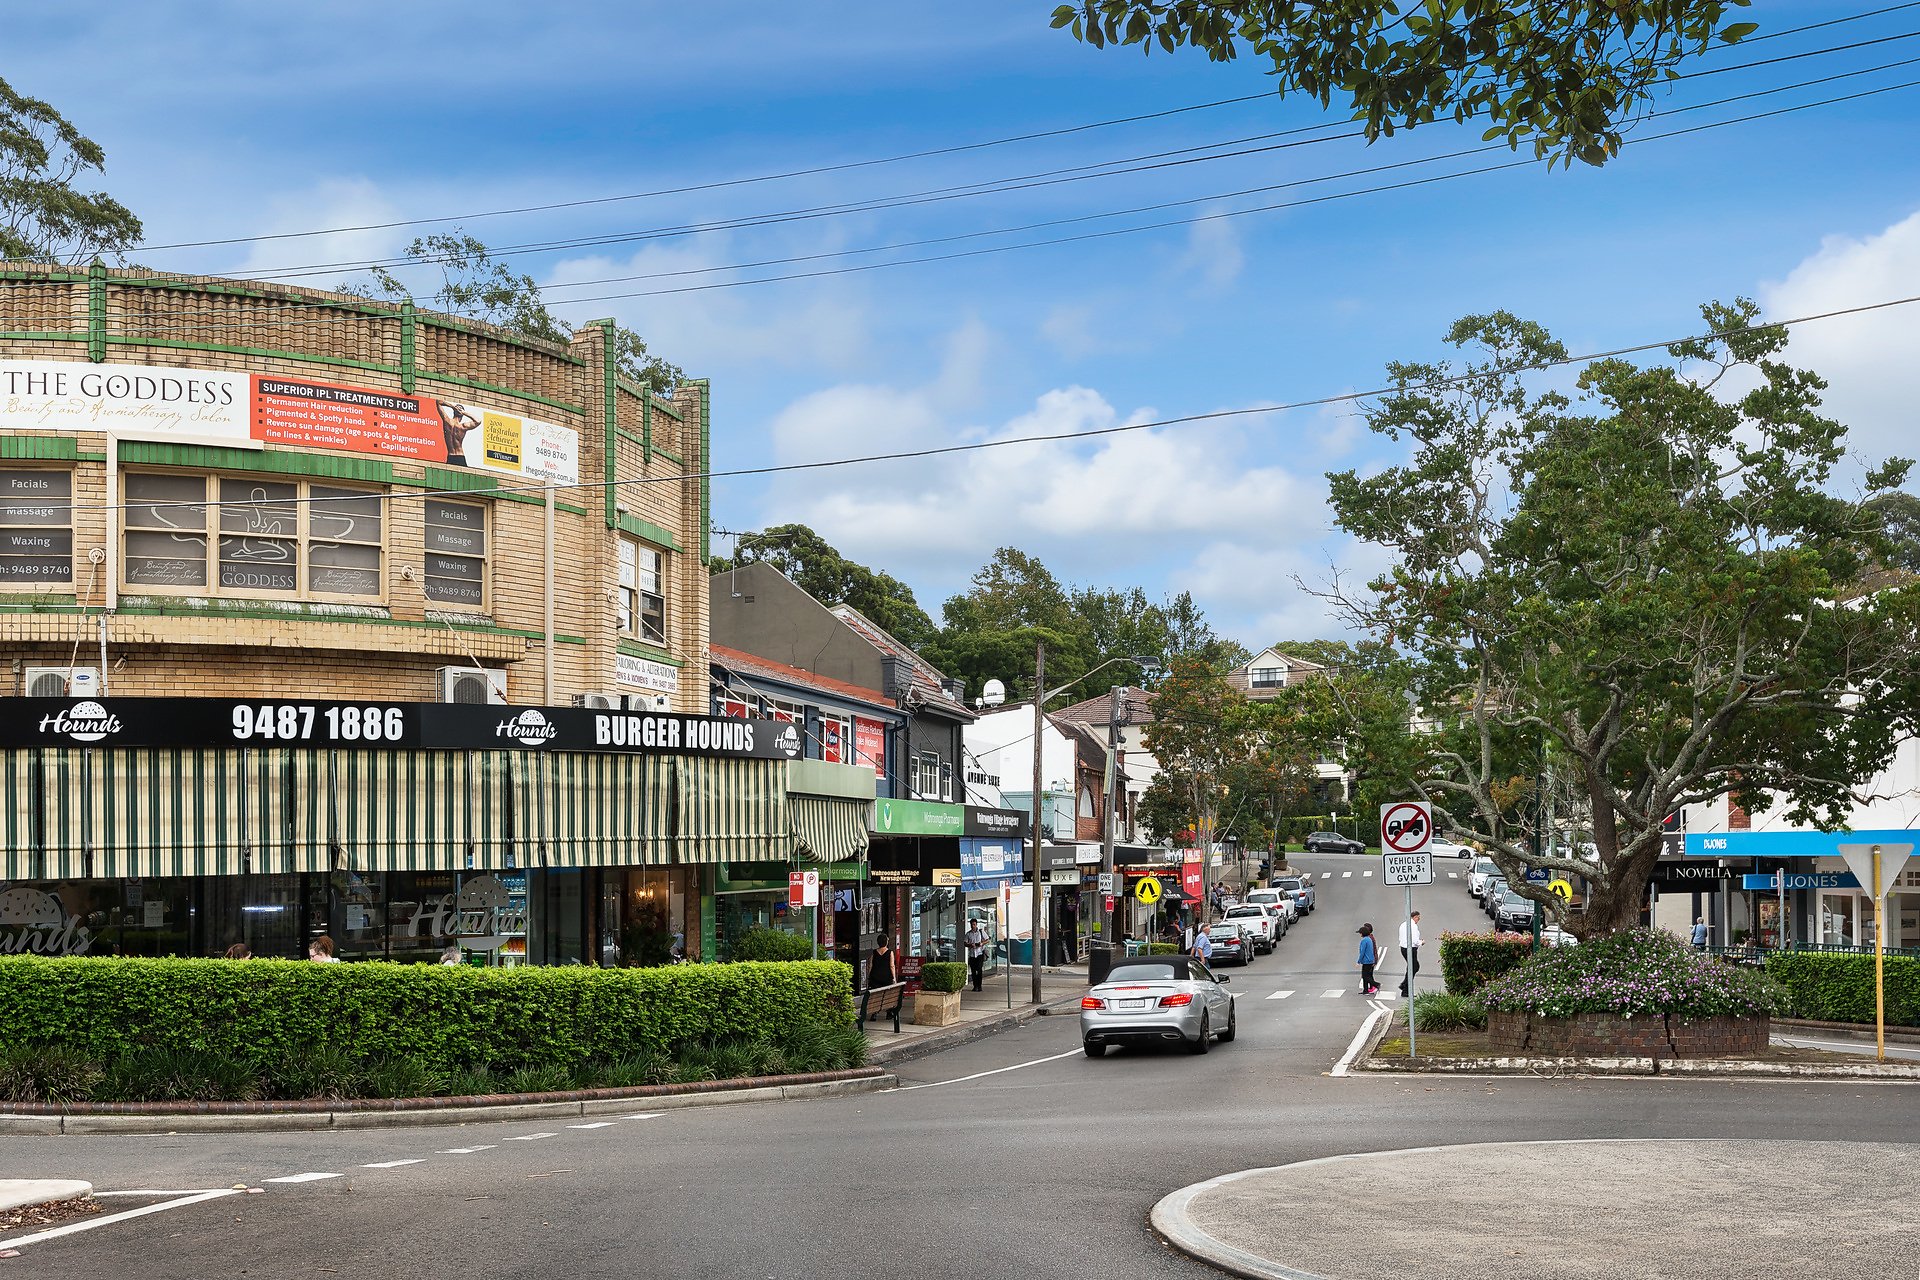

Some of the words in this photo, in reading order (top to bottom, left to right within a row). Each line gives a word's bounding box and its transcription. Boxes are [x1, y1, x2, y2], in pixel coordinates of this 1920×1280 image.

[3, 371, 68, 396] THE
[80, 373, 233, 406] GODDESS
[263, 382, 313, 397] SUPERIOR
[316, 389, 332, 399] IPL
[334, 391, 394, 408] TREATMENTS
[396, 400, 417, 411] FOR:
[3, 398, 53, 423] Beauty
[58, 398, 86, 415] and
[90, 398, 183, 429] Aromatherapy
[190, 405, 232, 423] Salon
[266, 397, 309, 408] Permanent
[310, 401, 327, 410] Hair
[328, 404, 363, 415] reduction
[266, 408, 308, 419] Pigmented
[310, 412, 317, 420] &
[319, 413, 343, 424] Spotty
[344, 416, 366, 426] hands
[380, 411, 396, 420] Skin
[397, 415, 438, 427] rejuvenation
[266, 419, 297, 429] Reverse
[314, 424, 344, 434] damage
[345, 428, 362, 437] (age
[363, 430, 383, 439] spots
[384, 431, 390, 440] &
[392, 434, 436, 446] pigmentation
[380, 421, 398, 430] Acne
[266, 429, 282, 438] fine
[283, 431, 302, 440] lines
[304, 433, 311, 441] &
[313, 434, 348, 445] wrinkles)
[541, 439, 562, 451] Phone:
[381, 442, 418, 454] Capillaries
[535, 446, 552, 458] 9489
[552, 452, 568, 462] 8740
[11, 478, 49, 489] Facials
[6, 504, 54, 517] Massage
[440, 509, 468, 521] Facials
[11, 535, 51, 548] Waxing
[437, 534, 472, 547] Massage
[0, 564, 9, 575] h:
[11, 565, 39, 575] 9489
[42, 565, 70, 575] 8740
[438, 560, 467, 573] Waxing
[222, 572, 294, 588] GODDESS
[424, 584, 437, 595] Ph:
[438, 586, 458, 597] 9489
[460, 589, 481, 599] 8740
[647, 664, 676, 680] ALTERATIONS
[38, 708, 124, 734] Hounds
[232, 705, 315, 740] 9487
[324, 707, 404, 741] 1886
[495, 716, 558, 740] Hounds
[595, 714, 680, 748] BURGER
[685, 719, 754, 753] HOUNDS
[1389, 855, 1426, 865] VEHICLES
[1389, 865, 1413, 874] OVER
[1415, 864, 1426, 873] 3t
[1675, 867, 1732, 879] NOVELLA
[1396, 873, 1418, 882] GVM
[407, 893, 533, 939] Hounds
[0, 913, 99, 956] unds
